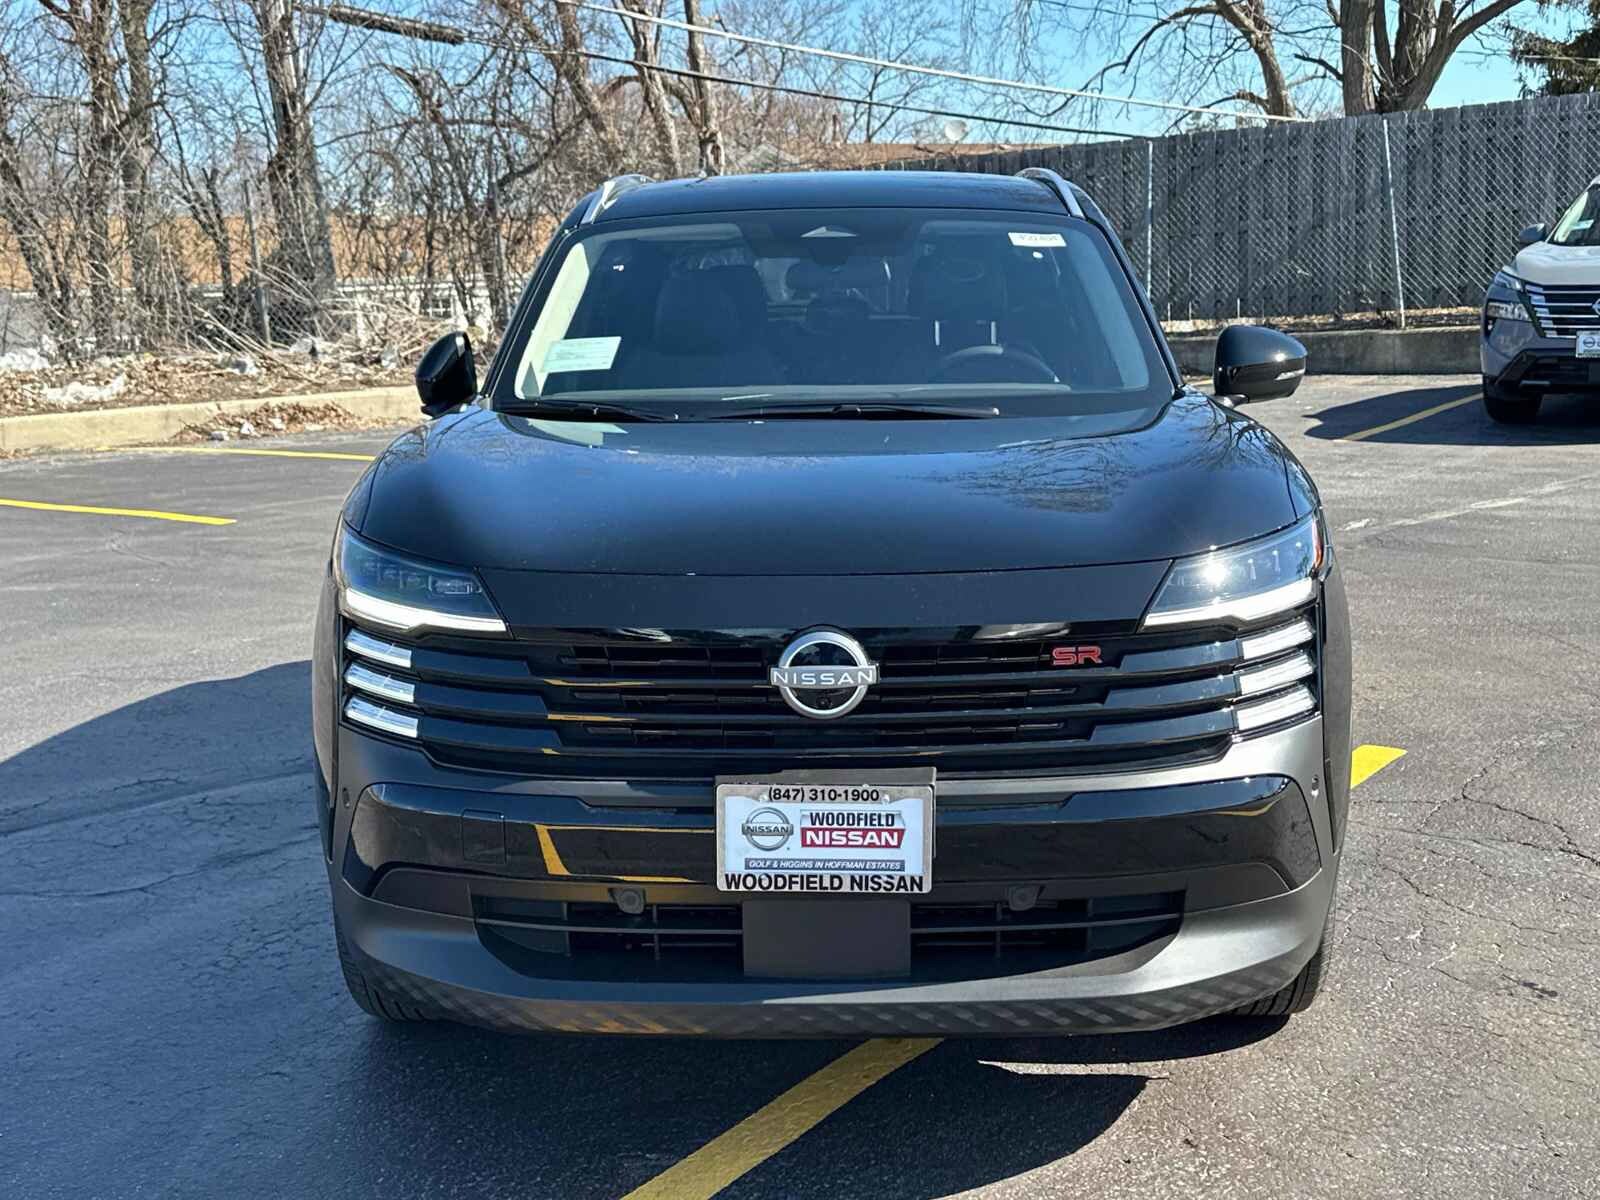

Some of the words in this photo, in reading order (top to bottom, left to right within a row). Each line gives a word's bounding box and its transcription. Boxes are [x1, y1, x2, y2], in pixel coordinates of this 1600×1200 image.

[1052, 646, 1103, 666] SR
[773, 669, 874, 685] NISSAN
[768, 787, 805, 802] (847)
[809, 787, 879, 802] 310-1900
[809, 812, 895, 827] WOODFIELD
[746, 825, 789, 834] NISSAN
[805, 830, 898, 847] NISSAN
[749, 859, 771, 868] GOLF
[772, 860, 779, 868] &
[780, 860, 814, 869] HIGGINS
[814, 861, 824, 869] IN
[824, 861, 865, 869] HOFFMAN
[865, 861, 901, 870] ESTATES
[724, 873, 843, 891] WOODFIELD
[850, 874, 924, 892] NISSAN
